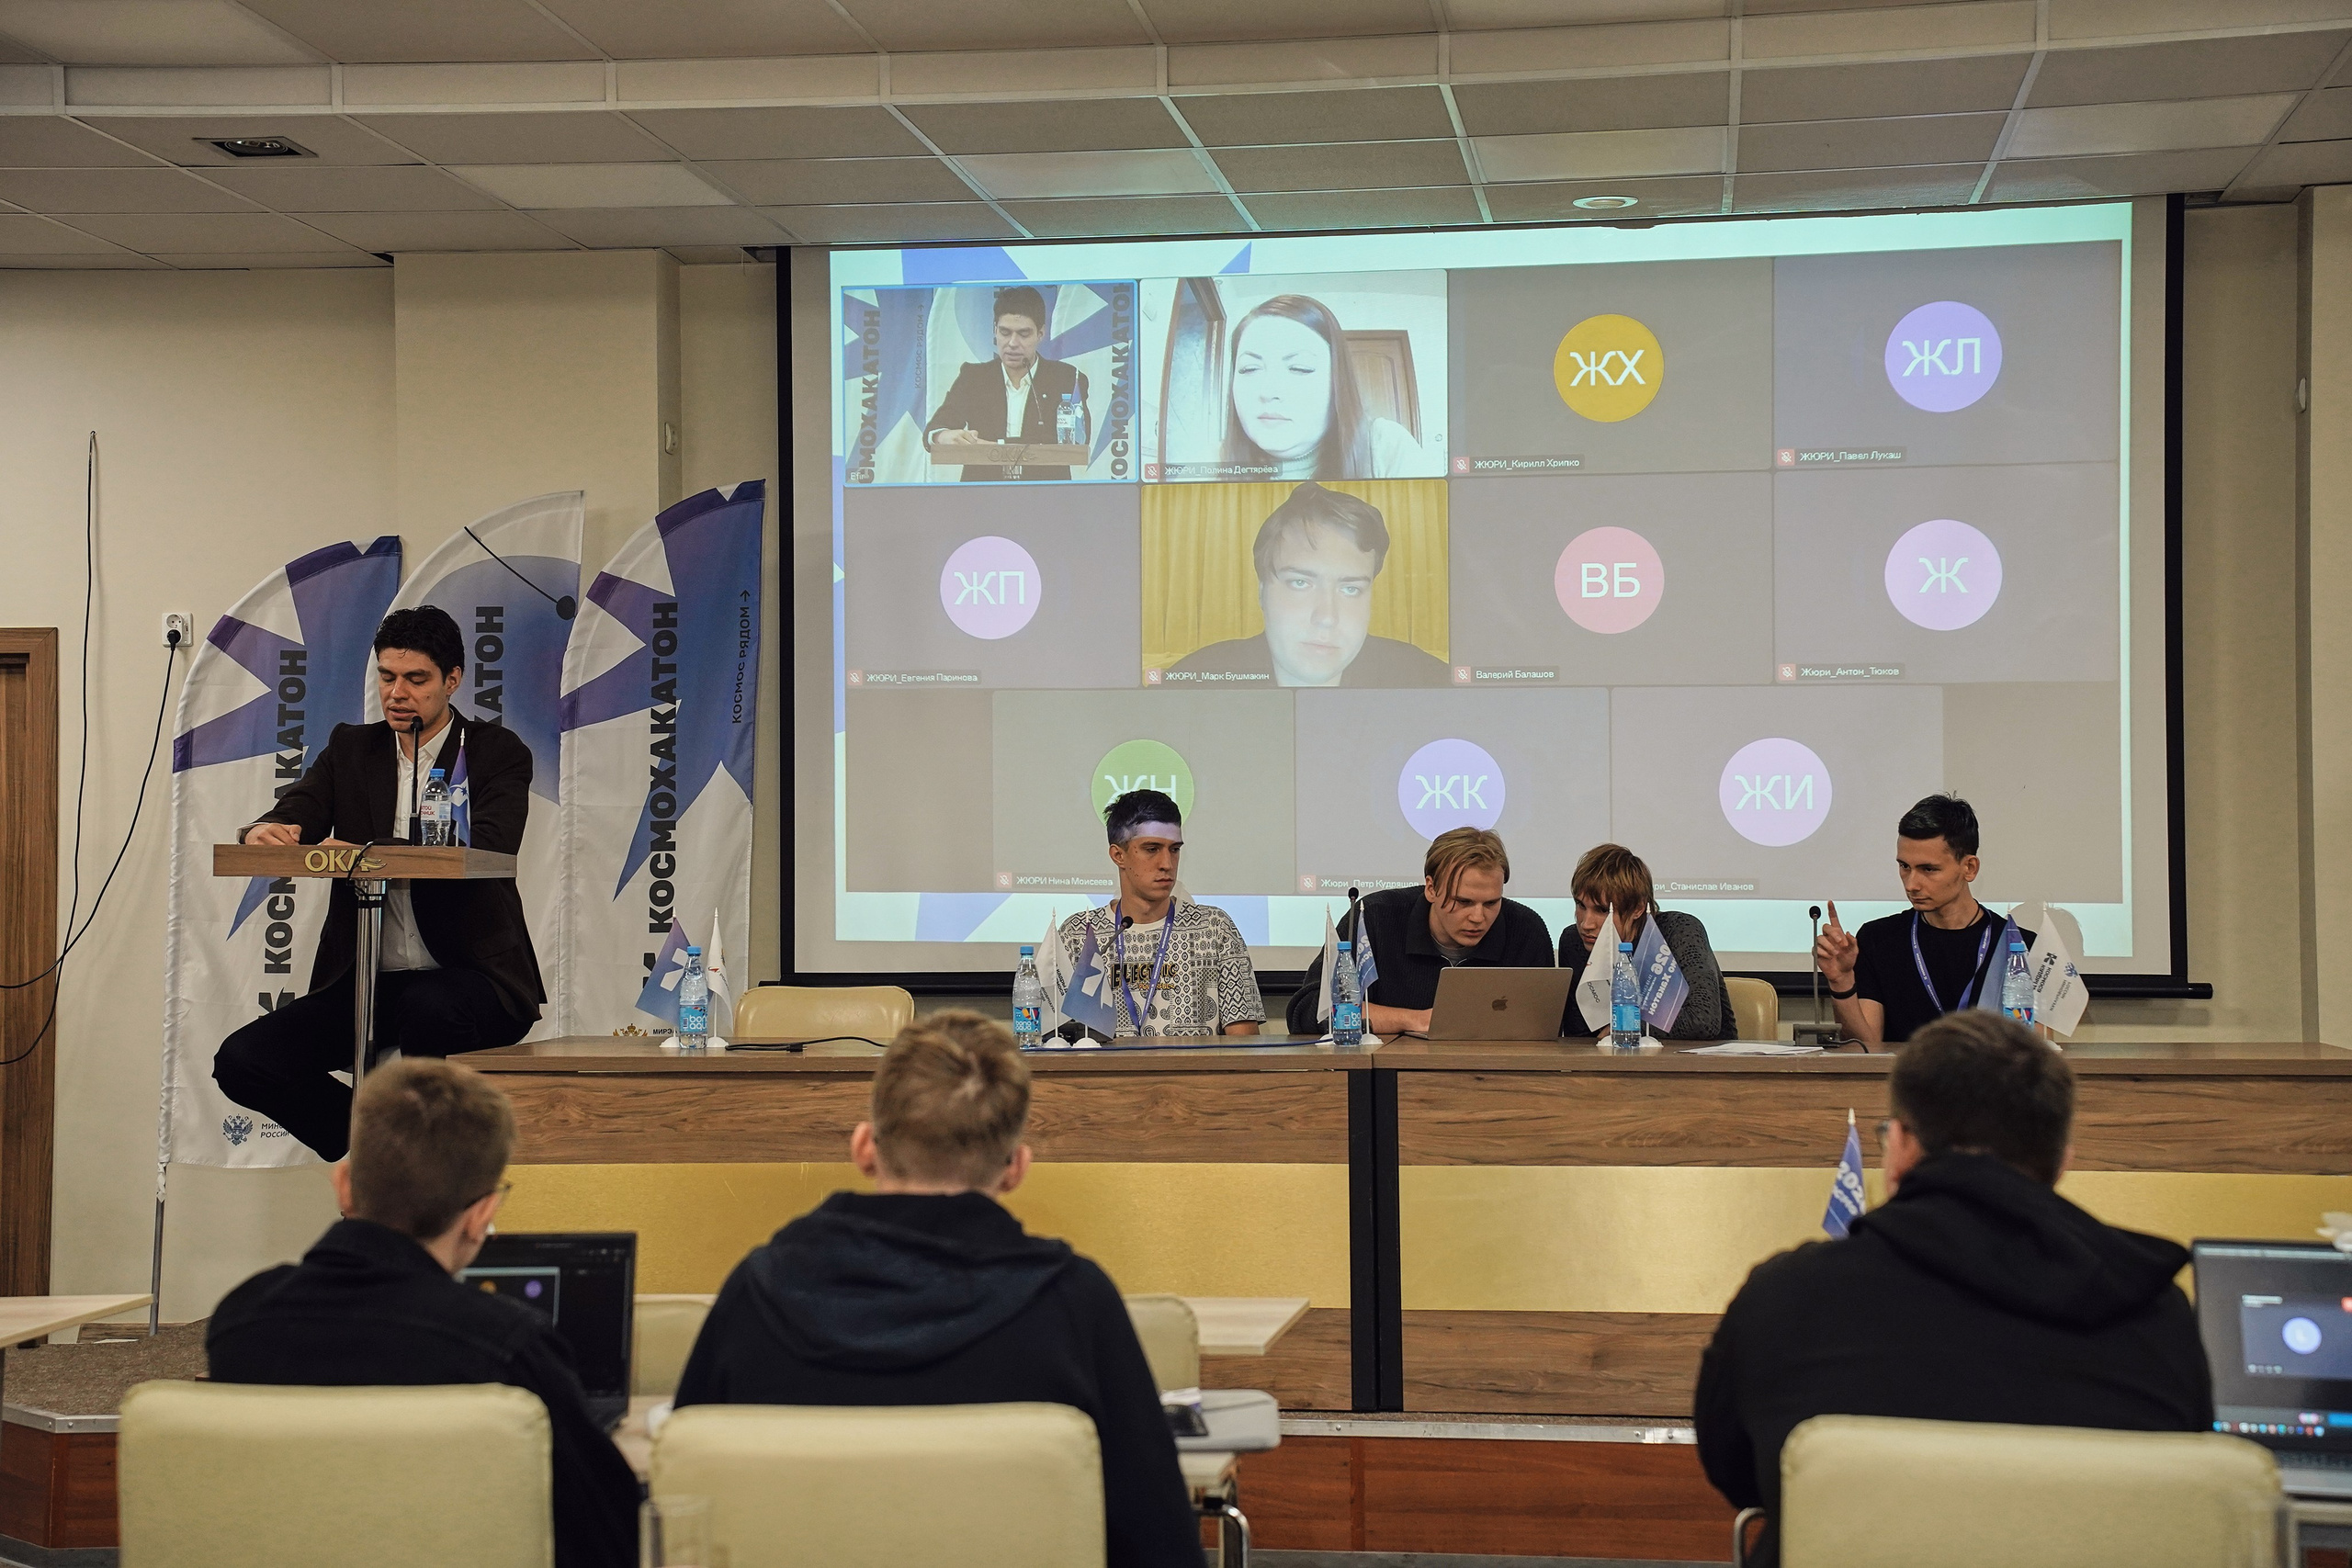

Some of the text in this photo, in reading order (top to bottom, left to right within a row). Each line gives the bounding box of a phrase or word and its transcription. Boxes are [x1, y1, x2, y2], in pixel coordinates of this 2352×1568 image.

[1569, 349, 1646, 387] ЖХ
[1902, 337, 1982, 377] ЖЛ
[1111, 283, 1130, 479] ОСМОХАКАТОН
[1164, 465, 1279, 476] ЖЮРИ_Полина Дегтярёва
[1474, 458, 1580, 470] ЖЮРИ_Кирилл Хрипко
[1800, 450, 1902, 462] ЖЮРИ_Павел Лукаш
[953, 570, 1025, 605] ЖП
[1580, 561, 1641, 598] ВБ
[1918, 557, 1969, 593] Ж
[732, 606, 752, 724] КОСМОС РЯДОМ
[866, 672, 978, 684] ЖЮРИ_Евгения Паринова
[1165, 671, 1270, 682] ЖЮРИ_Марк Бушмакин
[1476, 670, 1555, 680] Валерий Балашов
[649, 602, 678, 933] КОСМОХАКАТОН
[1415, 774, 1487, 809] ЖК
[1735, 774, 1814, 811] ЖИ
[1016, 875, 1114, 886] ЖЮРИ Нина Моисеева
[1654, 882, 1754, 892] ри_Станислав Иванов
[1111, 963, 1177, 990] ELECTIC
